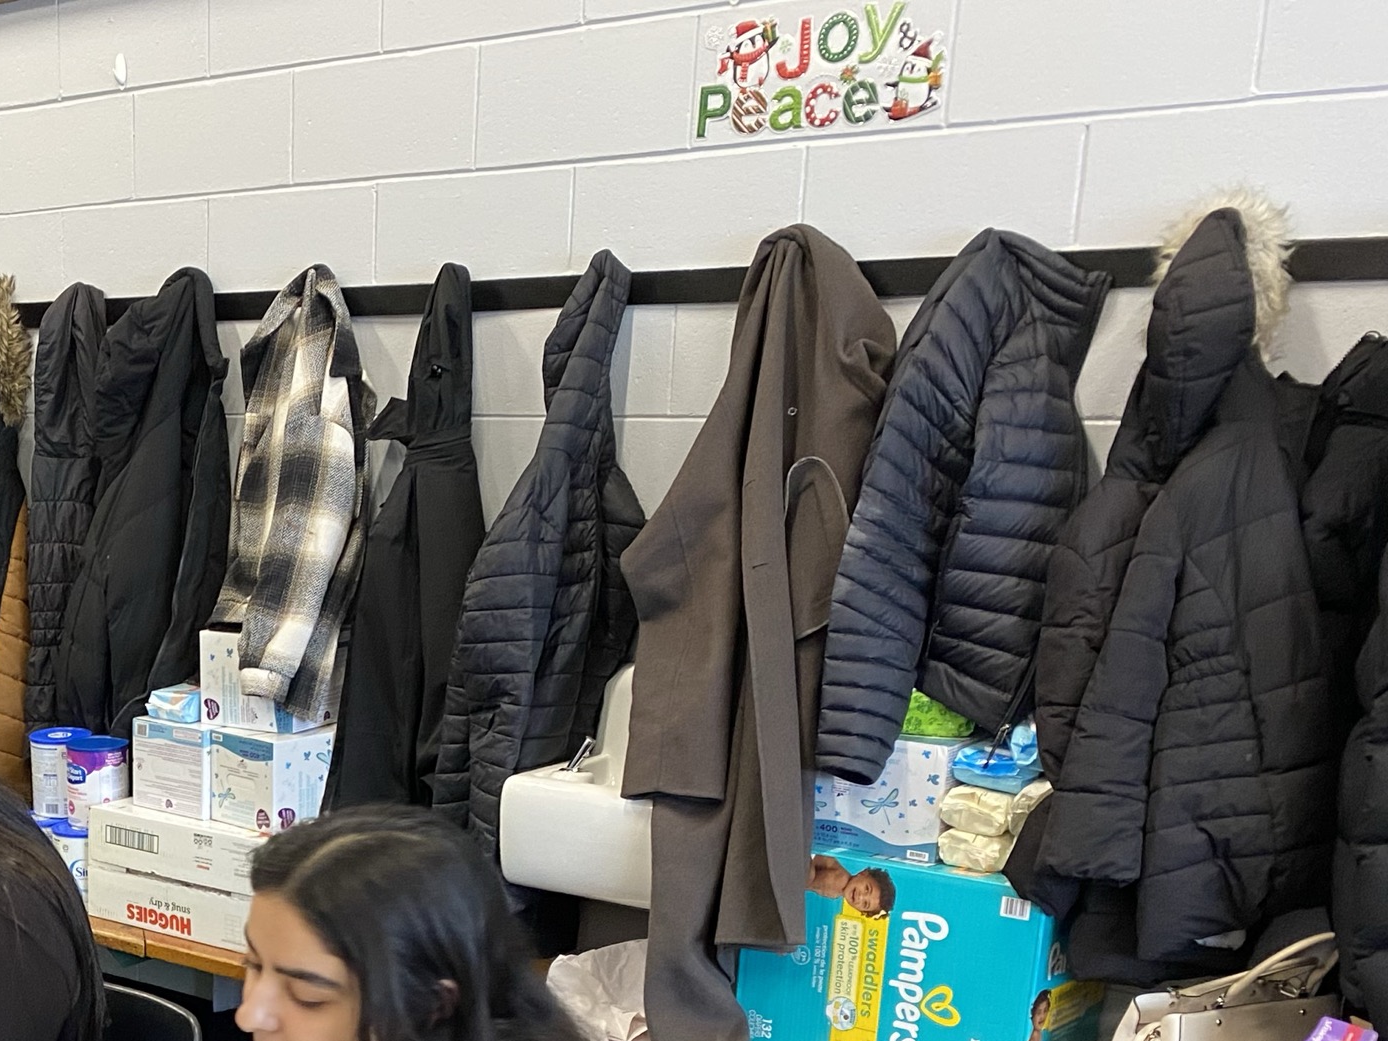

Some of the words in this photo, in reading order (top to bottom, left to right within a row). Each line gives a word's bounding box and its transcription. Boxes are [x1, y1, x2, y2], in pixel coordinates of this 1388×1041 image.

[696, 78, 880, 138] Peace
[820, 824, 838, 833] 400
[149, 897, 163, 910] dry
[163, 901, 171, 911] &
[171, 902, 191, 915] snug
[126, 903, 192, 937] HUGGIES
[838, 921, 849, 941] skin
[814, 945, 822, 958] 100
[820, 924, 829, 958] protection
[848, 936, 860, 961] 100%
[834, 942, 846, 995] protection
[845, 961, 855, 997] LEAKPROOF
[860, 930, 880, 1018] swaddlers
[762, 1019, 773, 1039] 132
